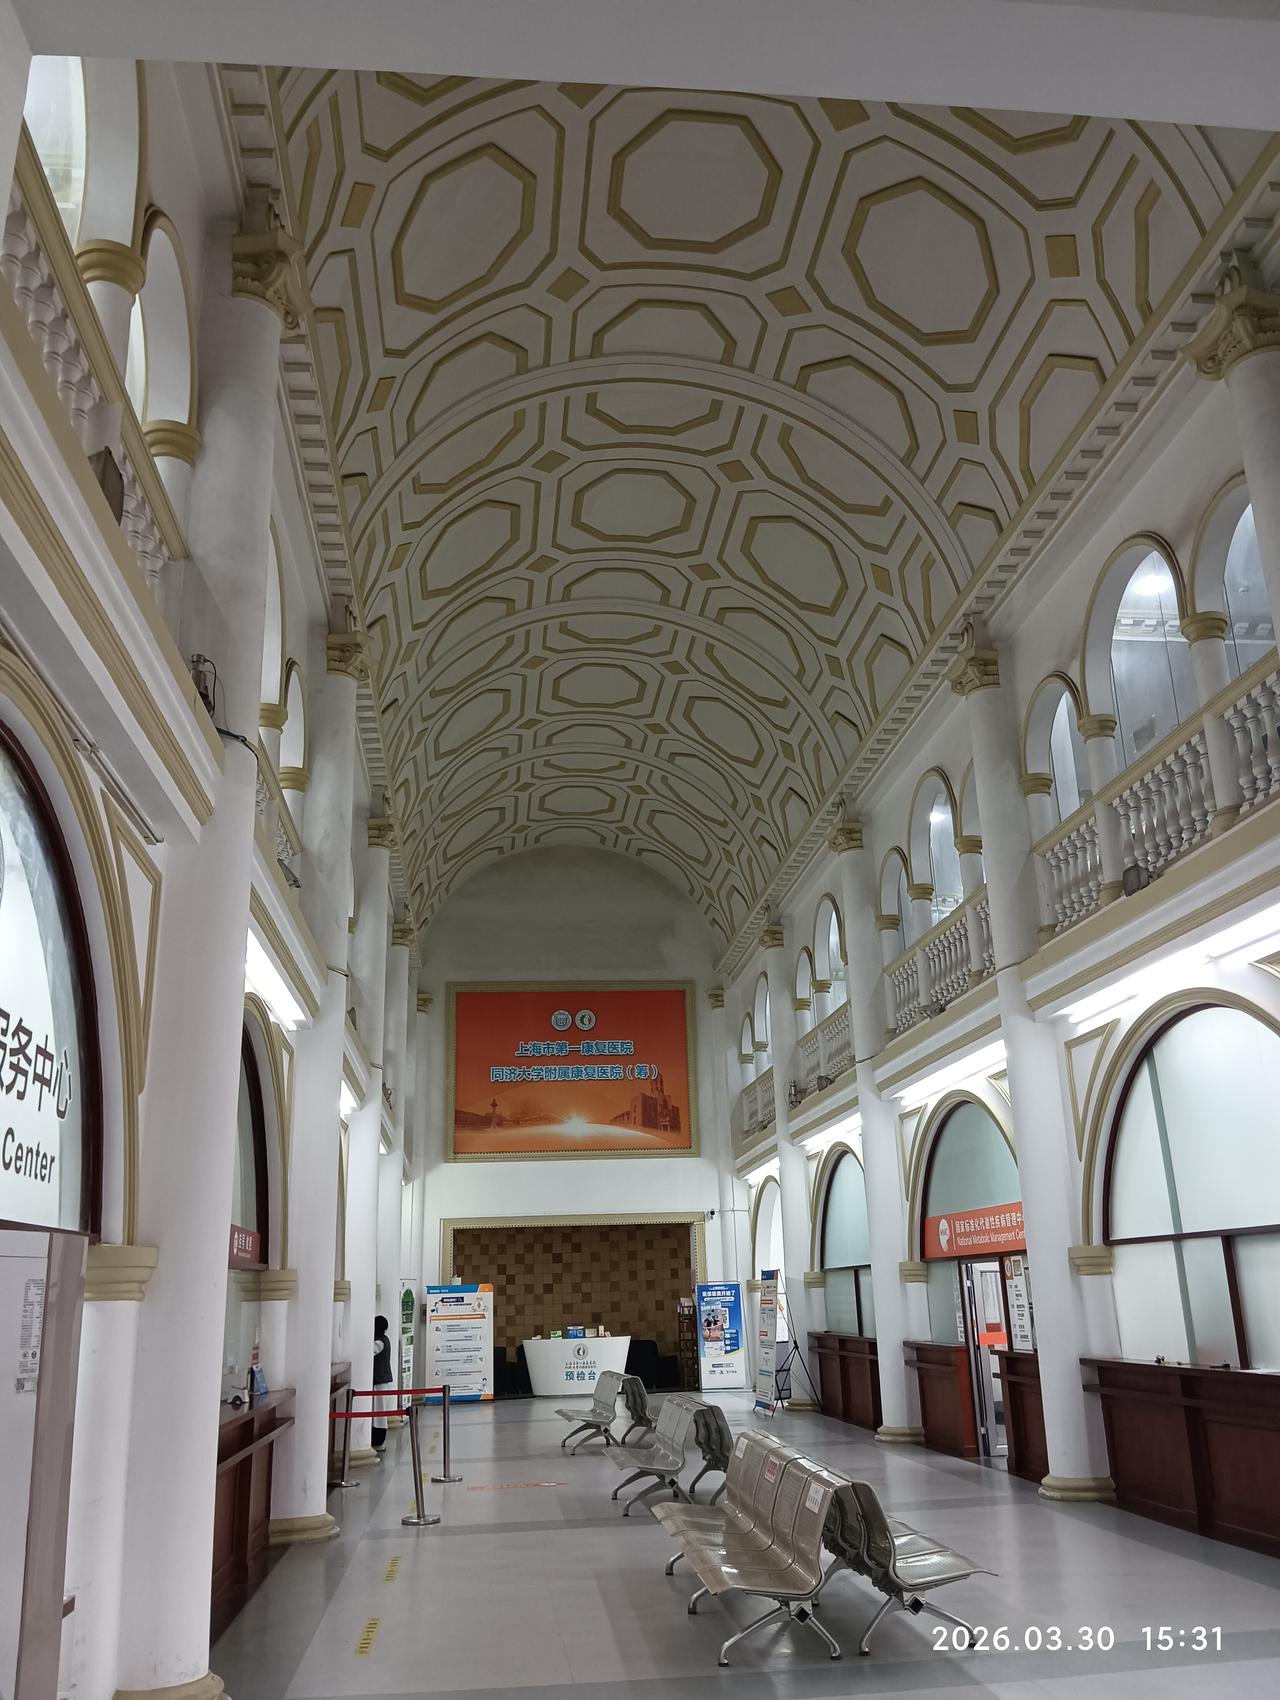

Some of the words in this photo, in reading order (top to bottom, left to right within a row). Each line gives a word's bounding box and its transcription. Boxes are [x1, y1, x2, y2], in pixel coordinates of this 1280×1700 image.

[515, 1040, 634, 1057] 上海市第一康复医院
[490, 1063, 659, 1082] 同济大学附属康复医院（筹）
[2, 1127, 55, 1184] Center
[1016, 1229, 1025, 1240] Cen
[565, 1370, 597, 1381] 预检台
